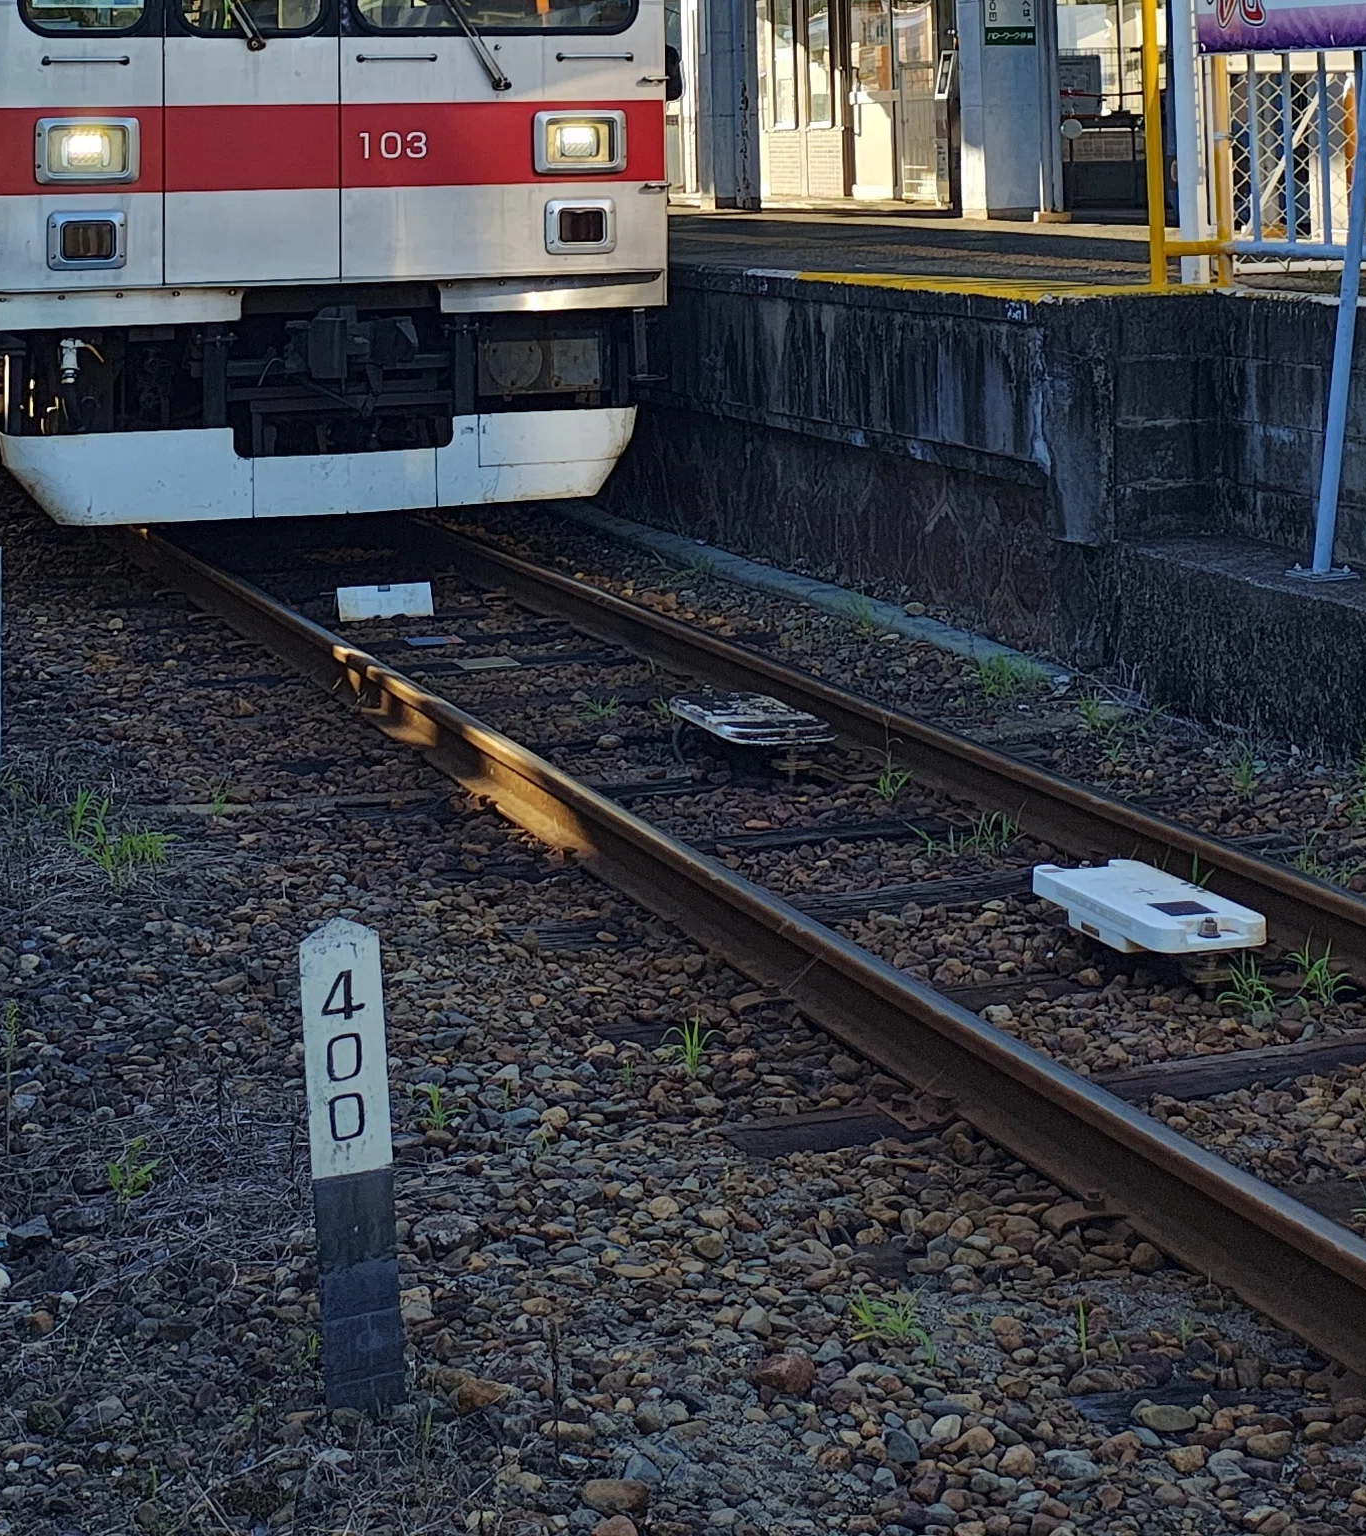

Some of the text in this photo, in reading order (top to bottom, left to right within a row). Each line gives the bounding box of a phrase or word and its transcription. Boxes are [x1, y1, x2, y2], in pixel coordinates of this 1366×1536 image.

[987, 31, 1033, 40] ハローワーク伊賀
[358, 131, 427, 159] 103
[320, 969, 366, 1142] 400
